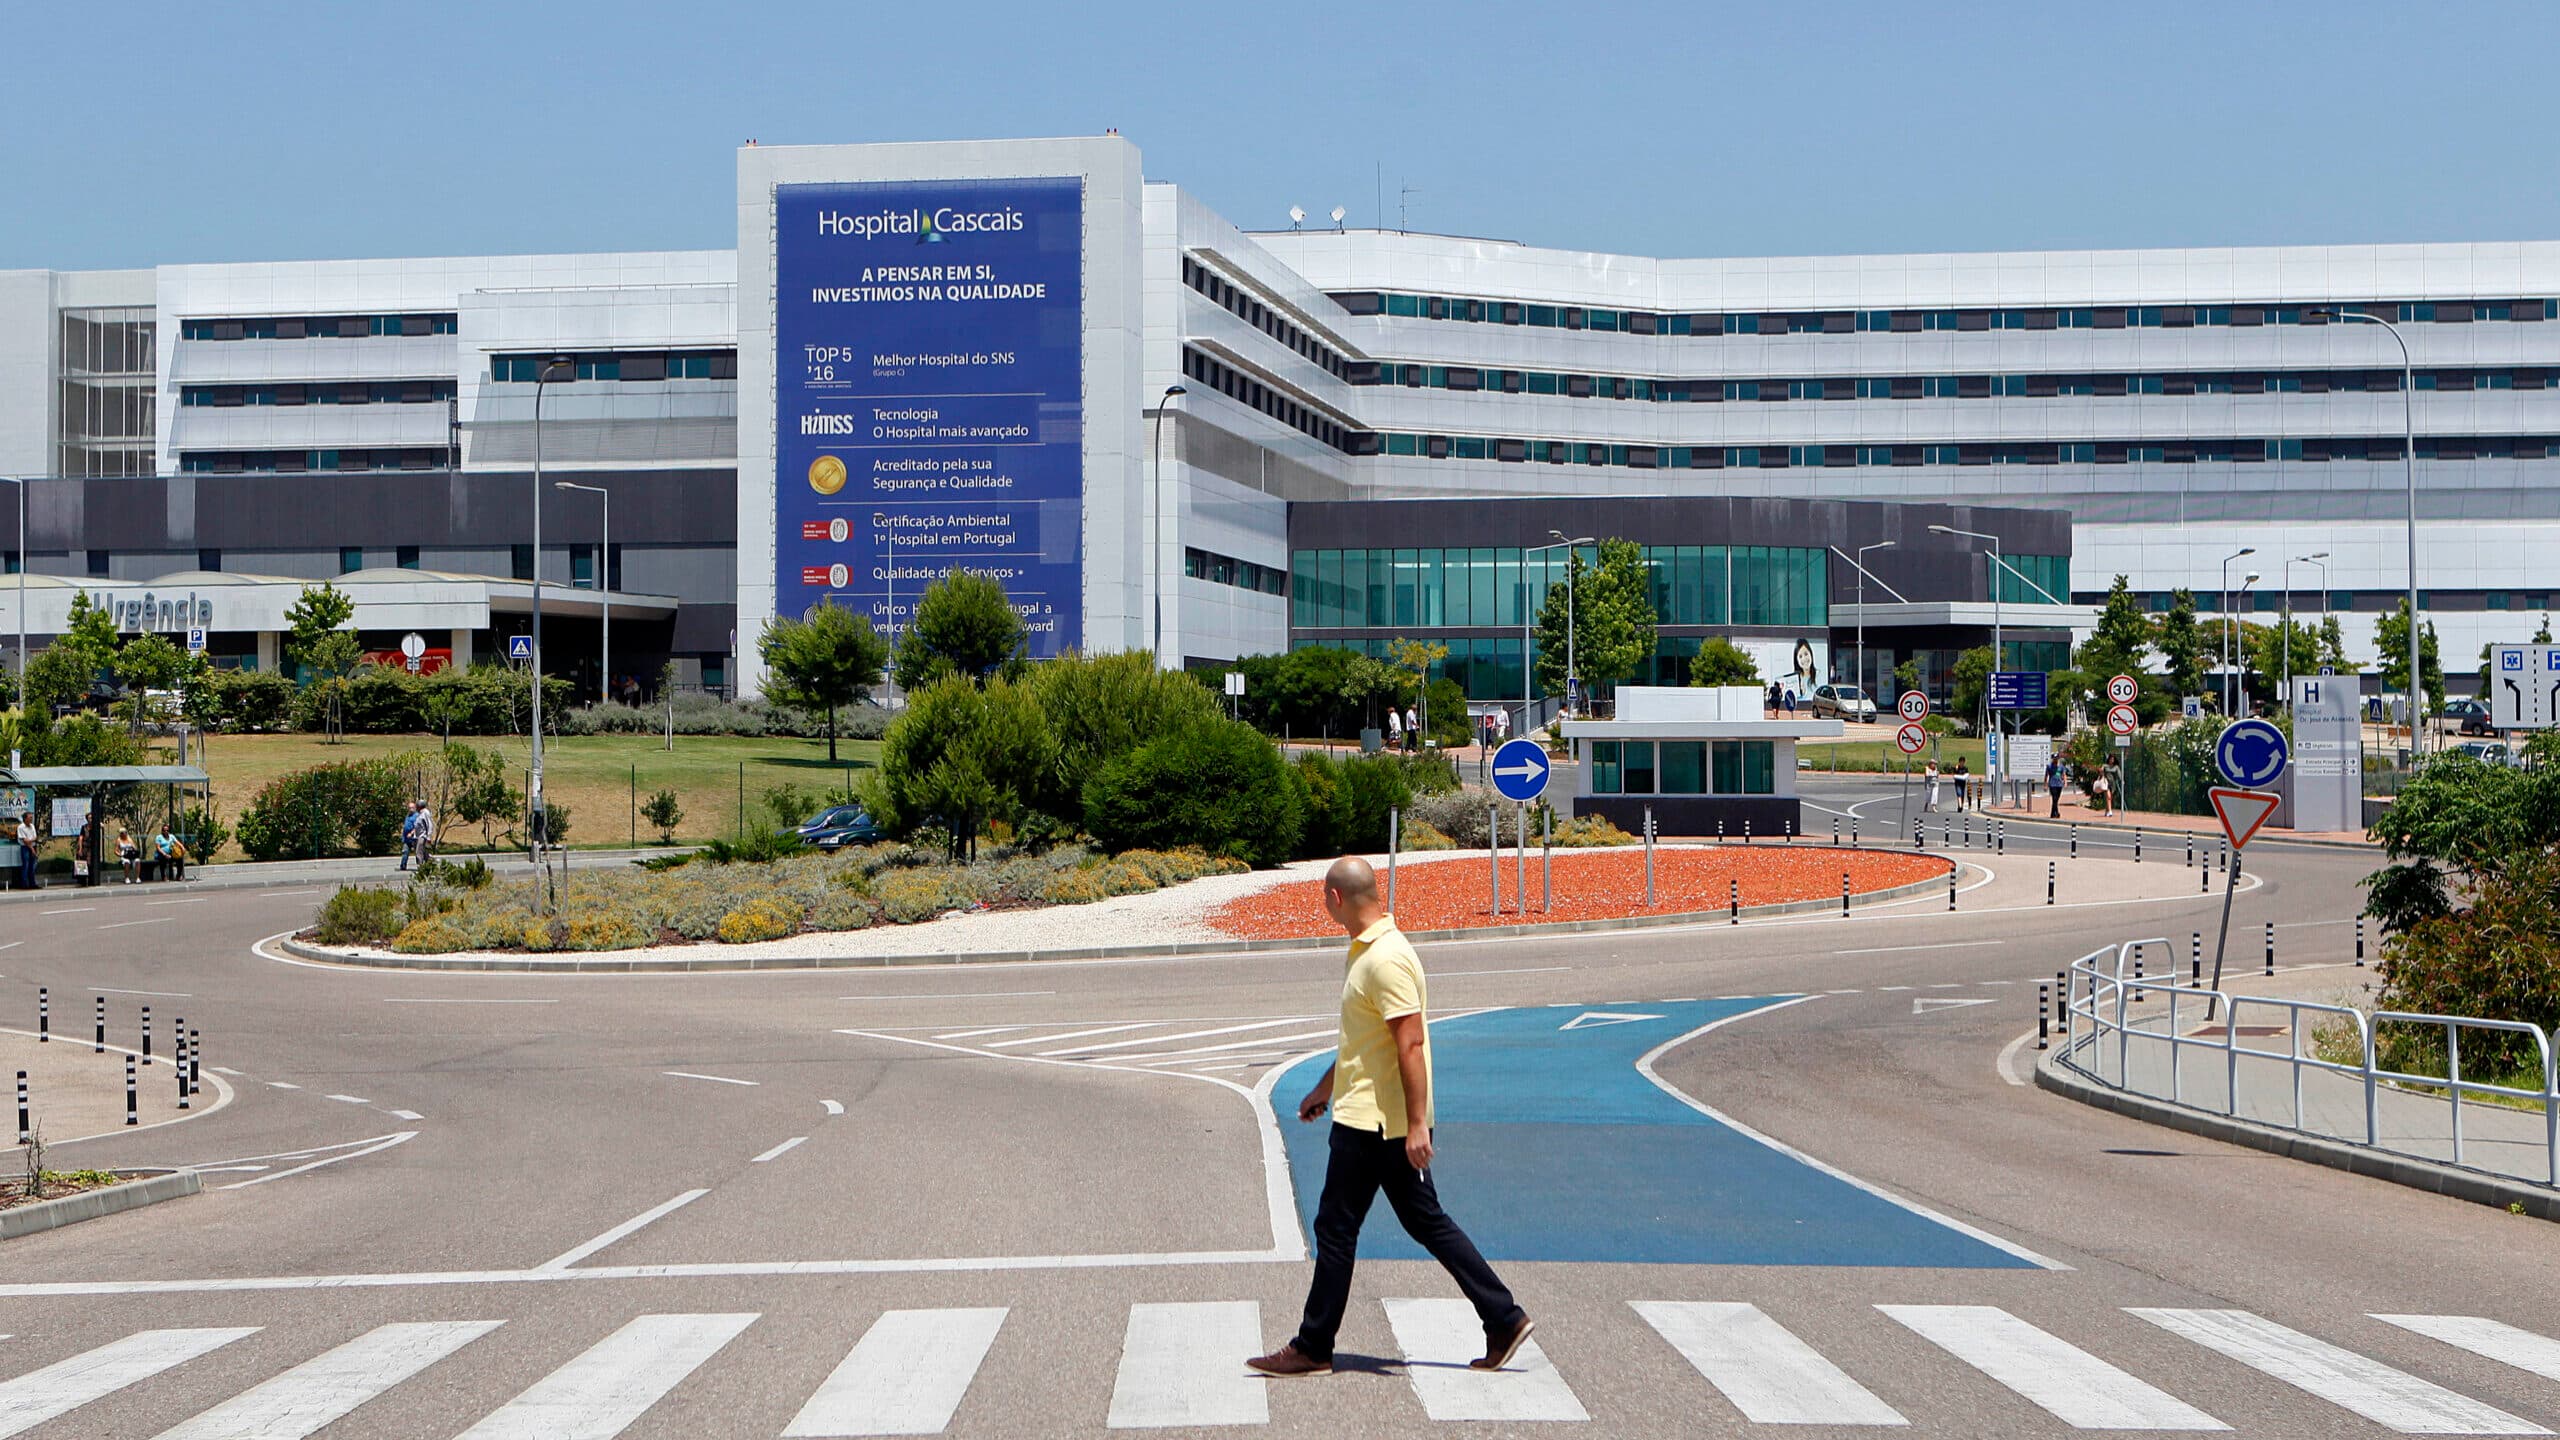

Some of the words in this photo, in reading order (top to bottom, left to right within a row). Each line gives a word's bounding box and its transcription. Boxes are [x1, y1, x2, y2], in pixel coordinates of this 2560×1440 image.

[820, 209, 918, 241] Hospital
[933, 207, 1024, 234] Cascais
[862, 268, 873, 282] A
[878, 267, 942, 282] PENSAR
[947, 266, 971, 280] EM
[976, 265, 996, 281] SI,
[812, 287, 914, 303] INVESTIMOS
[919, 286, 942, 300] NA
[947, 284, 1046, 301] QUALIDADE
[804, 347, 839, 363] TOP
[842, 347, 852, 362] 5
[873, 354, 916, 367] Melhor
[920, 353, 969, 368] Hospital
[972, 352, 988, 365] do
[991, 352, 1015, 364] SNS
[873, 408, 939, 423] Tecnologia
[873, 426, 883, 439] O
[886, 425, 936, 440] Hospital
[939, 425, 967, 438] mais
[970, 424, 1029, 440] avançado
[873, 458, 940, 472] Acreditado
[943, 458, 968, 473] pela
[971, 460, 992, 470] sua
[873, 476, 937, 492] Segurança
[940, 479, 947, 488] e
[949, 475, 1013, 489] Qualidade
[947, 513, 1010, 527] Ambiental
[874, 534, 886, 545] 1º
[942, 536, 961, 545] em
[964, 532, 1016, 547] Portugal
[873, 567, 935, 580] Qualidade
[938, 567, 957, 580] do
[963, 566, 1014, 581] Serviços
[93, 592, 213, 628] Urgência
[873, 601, 907, 616] Únco
[1044, 604, 1052, 614] a
[1021, 619, 1054, 632] ward
[193, 631, 200, 641] P
[2113, 684, 2132, 696] 30
[2304, 682, 2319, 703] H
[1904, 701, 1924, 713] 30
